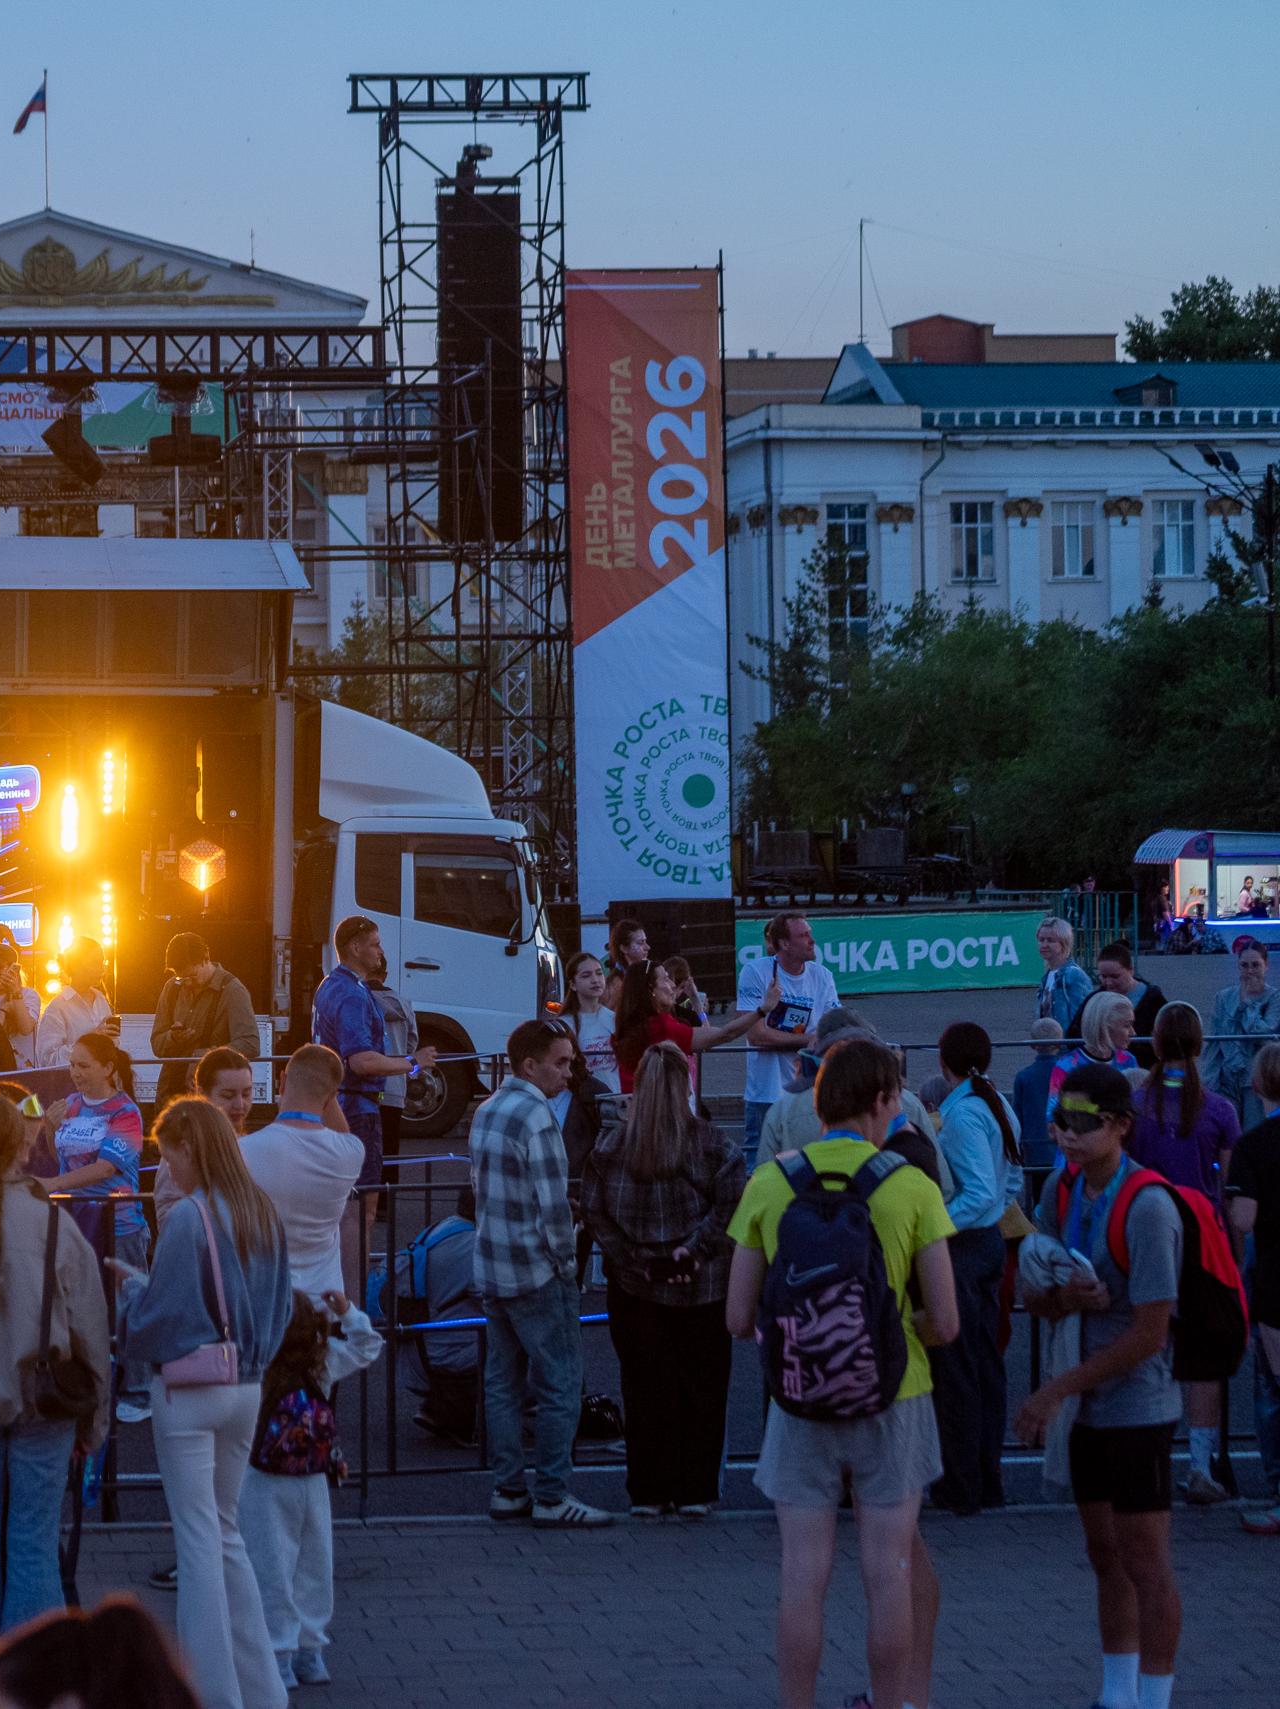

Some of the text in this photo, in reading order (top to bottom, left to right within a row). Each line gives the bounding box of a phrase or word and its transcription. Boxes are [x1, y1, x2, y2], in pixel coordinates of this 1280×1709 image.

[609, 355, 636, 569] МЕТАЛЛУРГА
[645, 354, 709, 569] 2026
[585, 479, 613, 570] ДЕНЬ
[613, 697, 686, 760] РОСТА
[699, 694, 729, 716] ТВ
[640, 727, 691, 769] РОСТА
[698, 726, 729, 747] ТВО
[604, 766, 638, 852] ТОЧКА
[633, 773, 656, 832] ТОЧКА
[906, 935, 1020, 971] РОСТА
